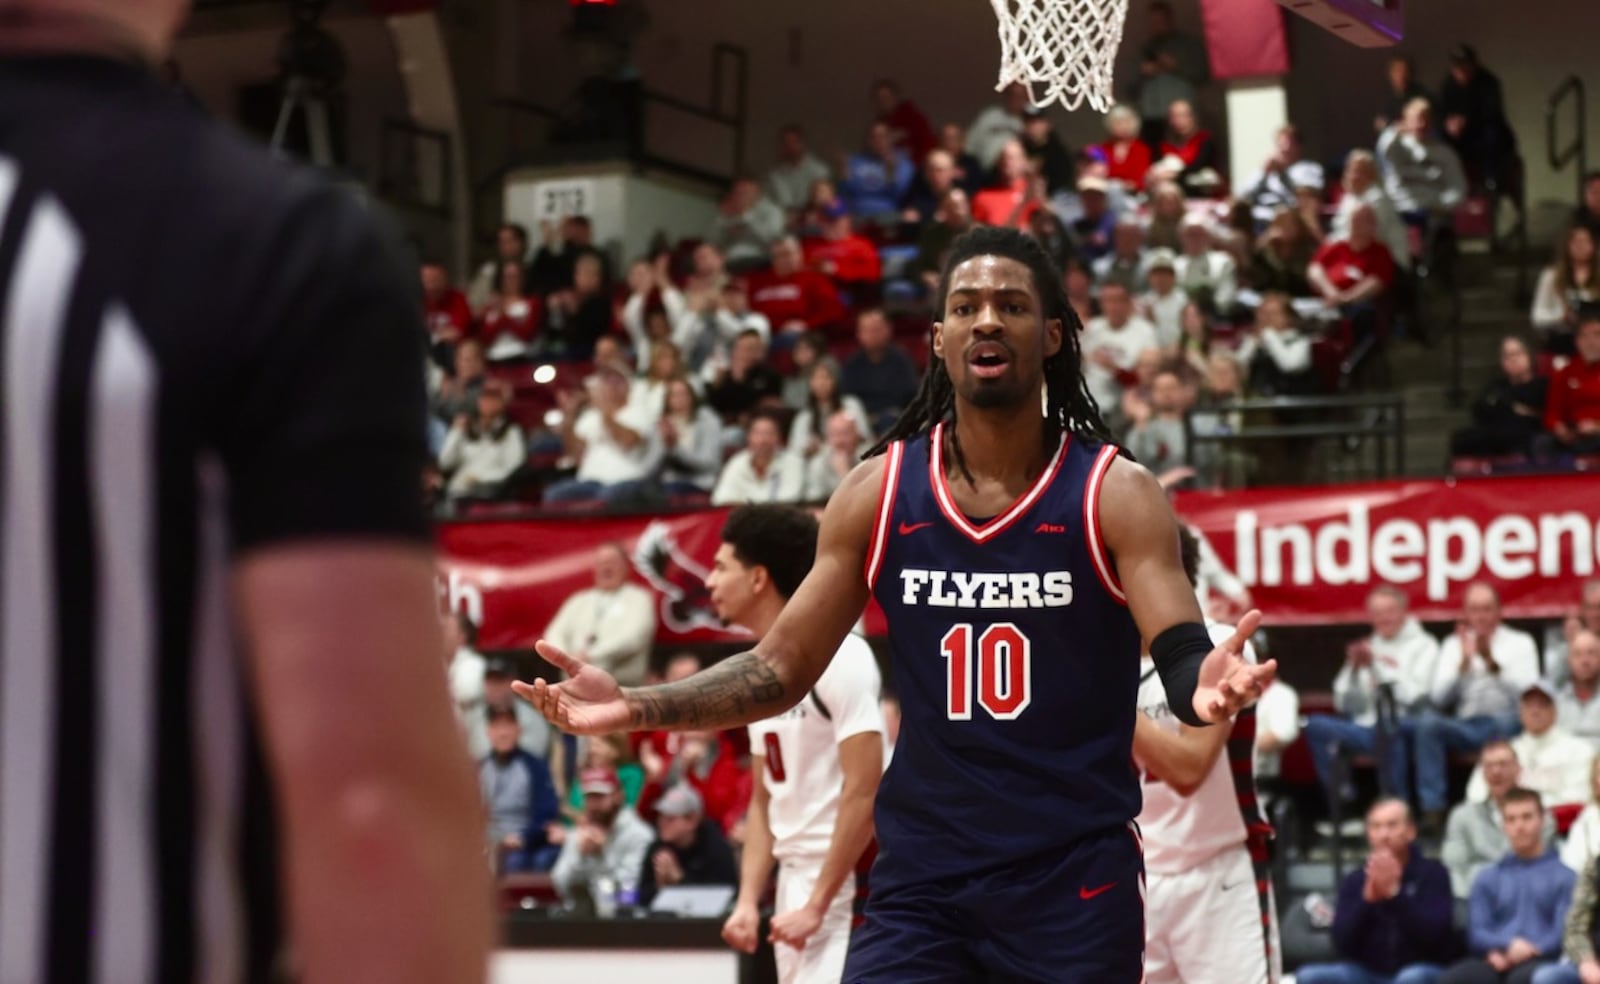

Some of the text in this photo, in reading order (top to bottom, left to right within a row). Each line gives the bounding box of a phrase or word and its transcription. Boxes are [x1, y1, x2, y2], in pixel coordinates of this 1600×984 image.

[1235, 501, 1600, 600] Indepen
[900, 569, 1073, 608] FLYERS
[941, 623, 1031, 720] 10
[764, 732, 786, 783] 0
